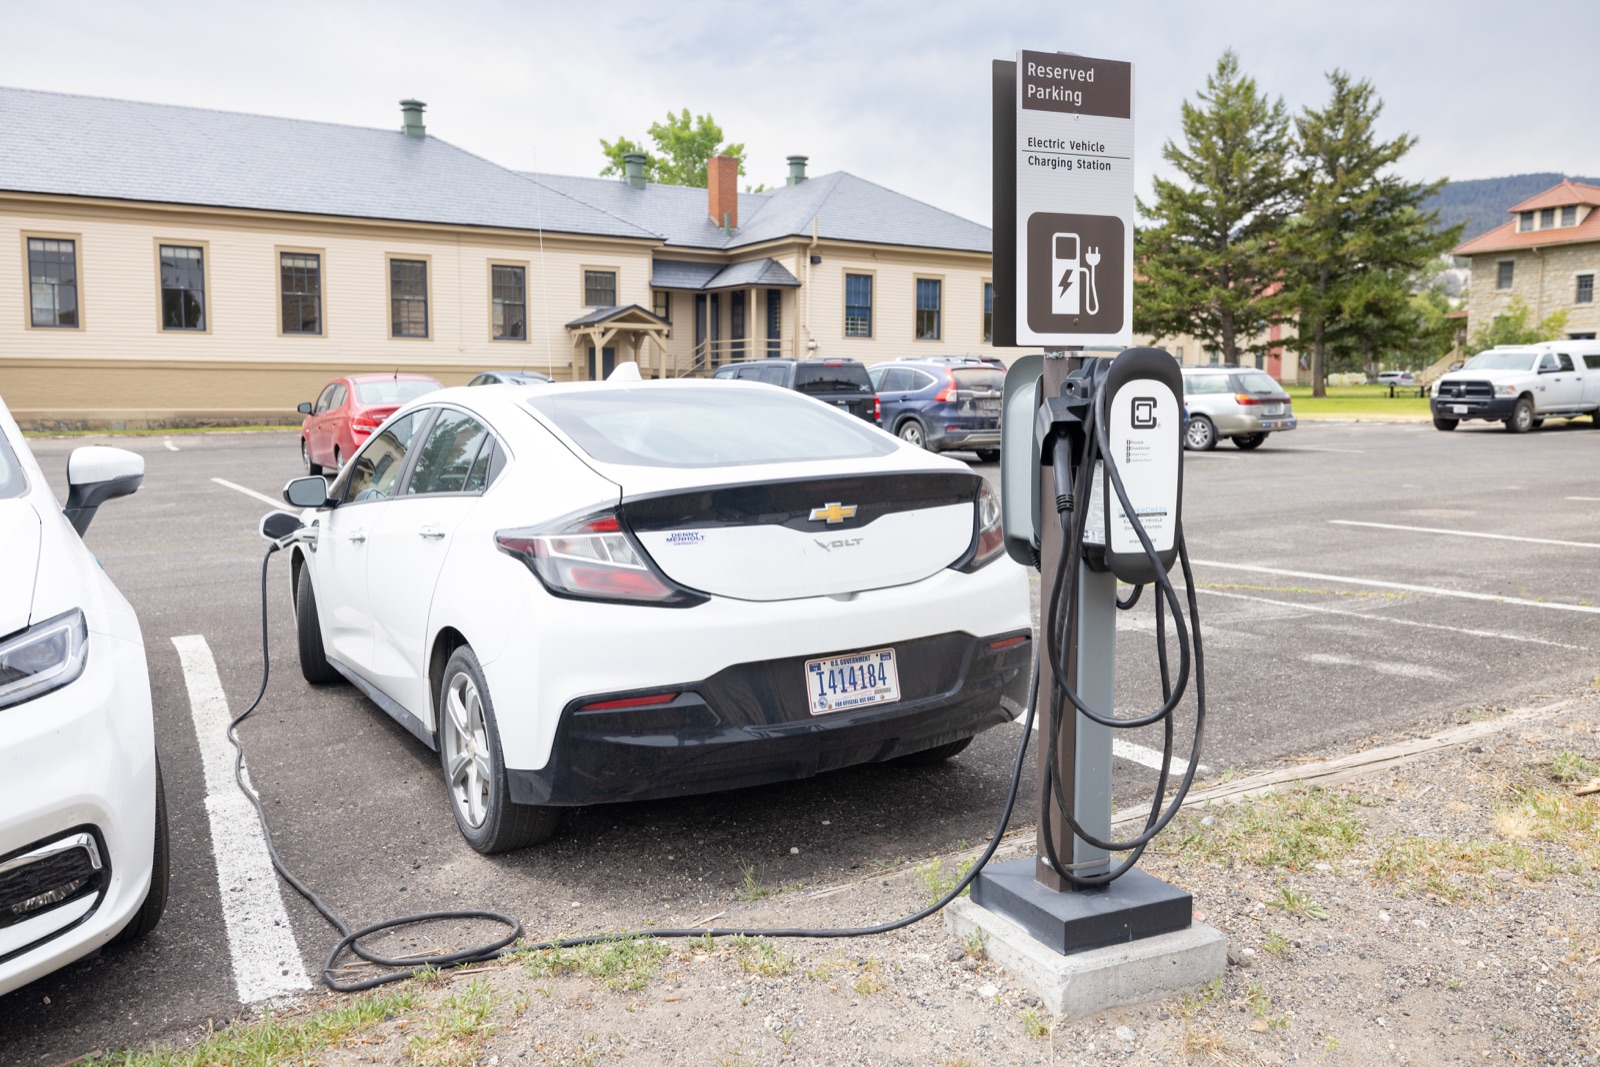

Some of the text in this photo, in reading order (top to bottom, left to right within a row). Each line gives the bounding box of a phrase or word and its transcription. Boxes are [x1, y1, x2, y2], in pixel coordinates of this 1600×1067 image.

[1027, 62, 1095, 83] Reserved
[1027, 84, 1082, 106] Parking
[1027, 137, 1105, 153] Electric Vehicle
[1027, 156, 1111, 171] Charging Station
[813, 538, 864, 552] VOLT
[840, 655, 870, 666] GOVERNMENT
[842, 698, 859, 706] OFFICIAL
